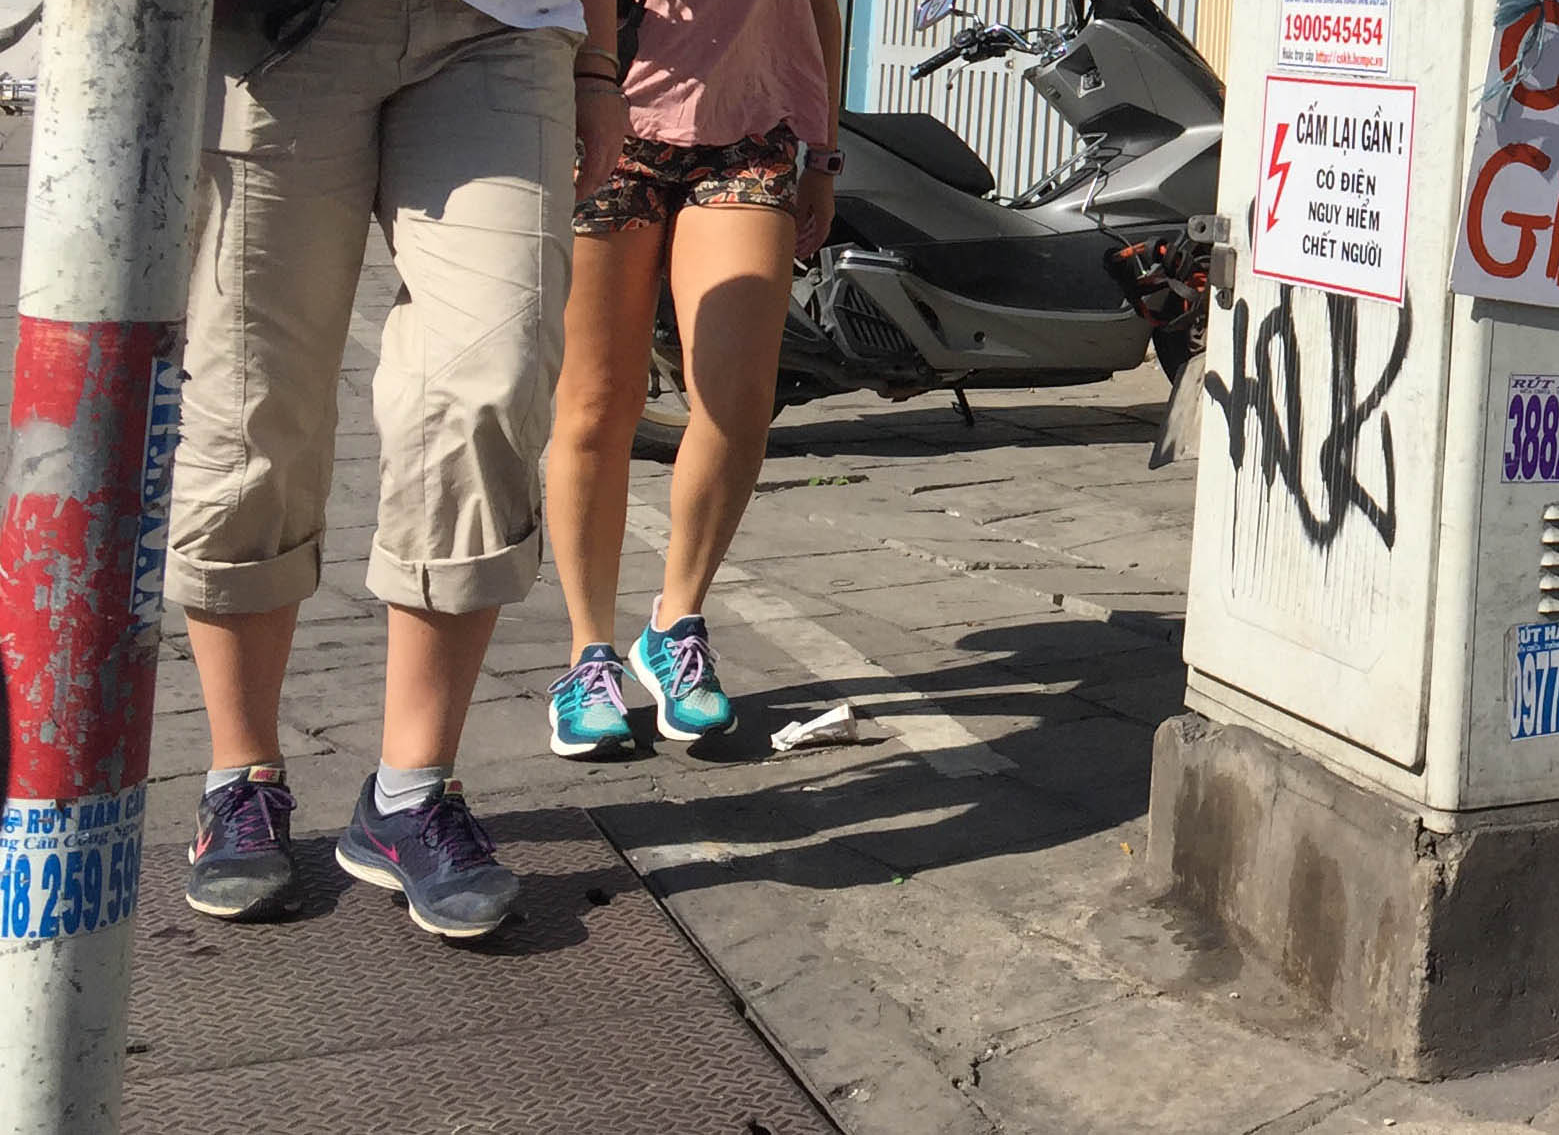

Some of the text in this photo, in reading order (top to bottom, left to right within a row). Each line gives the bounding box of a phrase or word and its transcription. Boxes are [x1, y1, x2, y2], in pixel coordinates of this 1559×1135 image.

[1284, 13, 1383, 46] 1900545454
[1296, 100, 1328, 146] CẤM
[1332, 116, 1357, 156] LẠI
[1361, 105, 1392, 153] GẦN
[1316, 164, 1377, 198] CÓ ĐIỆN
[1308, 198, 1380, 231] NGUY HIỂM
[1302, 230, 1382, 268] CHẾT NGƯỜI
